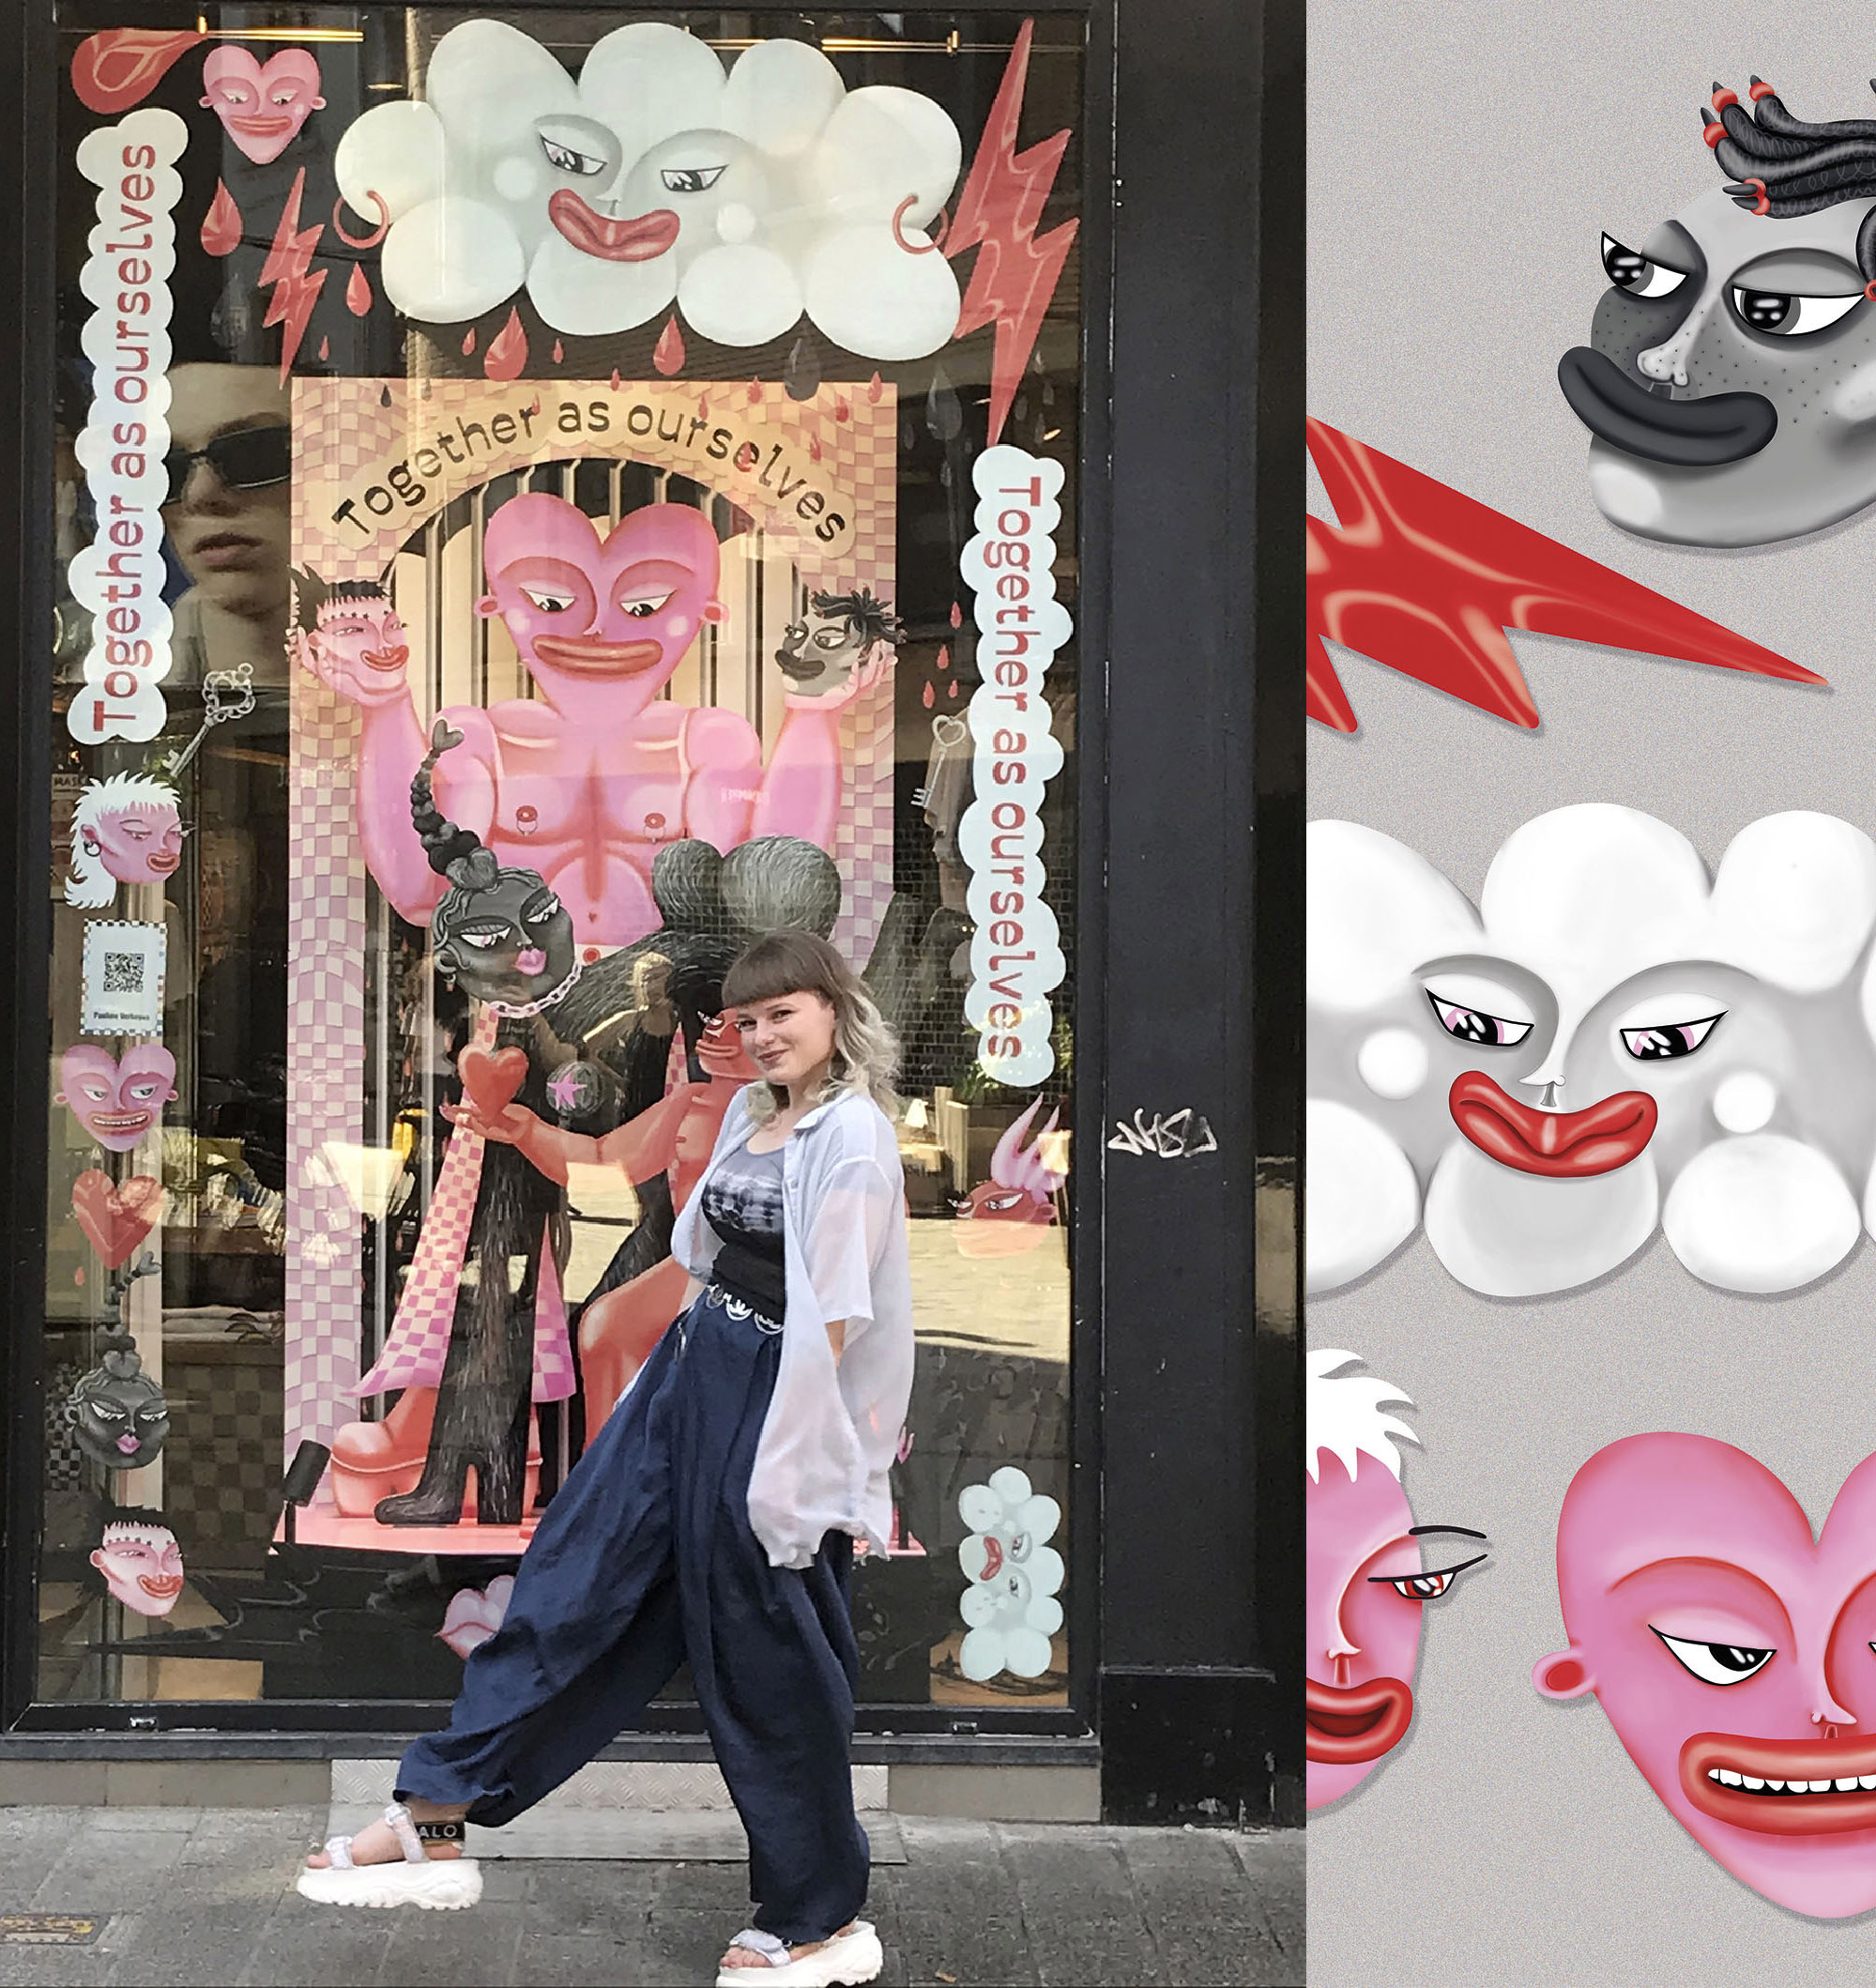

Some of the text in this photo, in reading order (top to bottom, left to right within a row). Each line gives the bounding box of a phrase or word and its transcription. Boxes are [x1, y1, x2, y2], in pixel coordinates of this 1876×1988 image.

[93, 144, 156, 732] Together as ourselves
[331, 401, 846, 543] Together as ourselves
[983, 476, 1042, 1060] Together as ourselves
